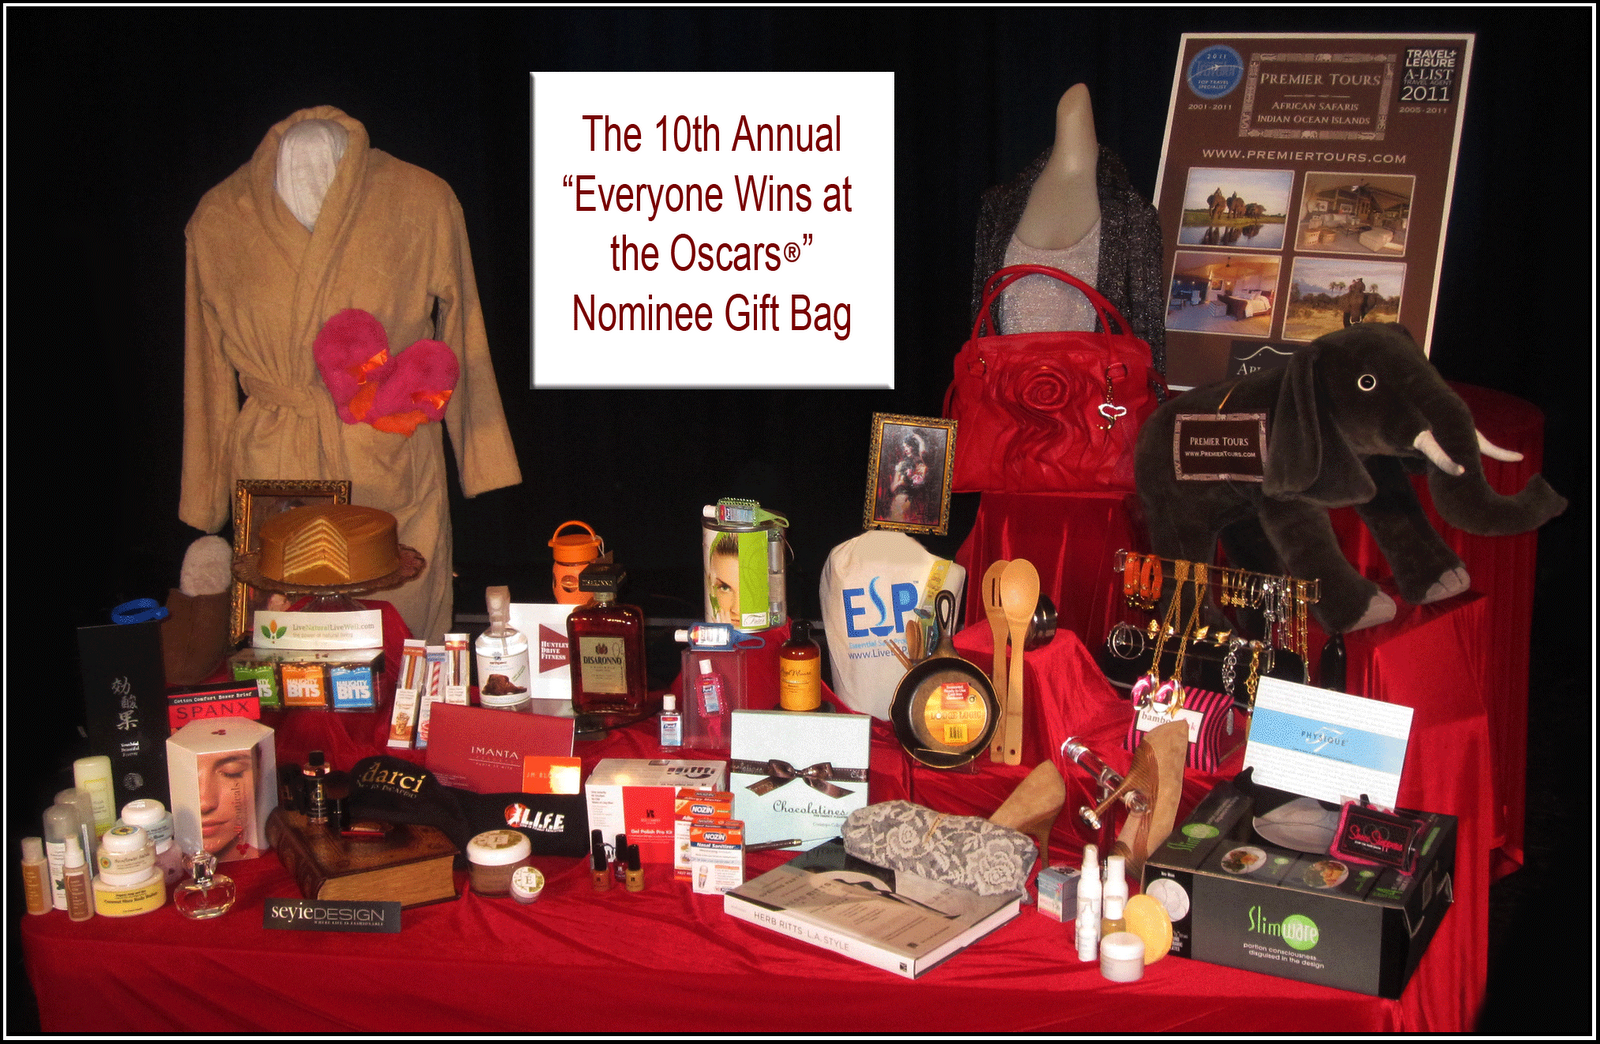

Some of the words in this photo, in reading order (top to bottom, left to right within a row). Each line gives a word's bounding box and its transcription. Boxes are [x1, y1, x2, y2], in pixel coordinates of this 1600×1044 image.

[1405, 58, 1456, 68] LEISURE
[1260, 72, 1324, 85] PREMIER
[1329, 73, 1381, 86] TOURS
[1404, 68, 1450, 80] A-LIST
[1401, 85, 1450, 102] 2011
[1272, 101, 1316, 110] AFRICAN
[1318, 102, 1359, 111] SAFARIS
[1258, 114, 1291, 123] INDIAN
[1293, 115, 1329, 124] OCEAN
[1331, 116, 1371, 125] ISLANDS
[1202, 148, 1407, 165] WWW.PREMIERTOURS.COM
[583, 655, 622, 665] DISARONNO
[287, 684, 321, 698] BITS
[337, 685, 371, 700] BITS
[193, 695, 217, 703] Comfort
[176, 701, 250, 720] SPANX
[1301, 730, 1347, 747] PHYSIQUE
[471, 745, 519, 760] IMANTA
[362, 761, 427, 793] darci
[692, 805, 714, 814] NOZIN
[772, 799, 847, 816] Chocolatines
[704, 833, 725, 841] NOZIN
[753, 910, 778, 926] HERB
[778, 919, 803, 935] RITTS
[823, 934, 850, 951] STYLE
[1243, 942, 1268, 952] portion
[1301, 959, 1325, 970] design
